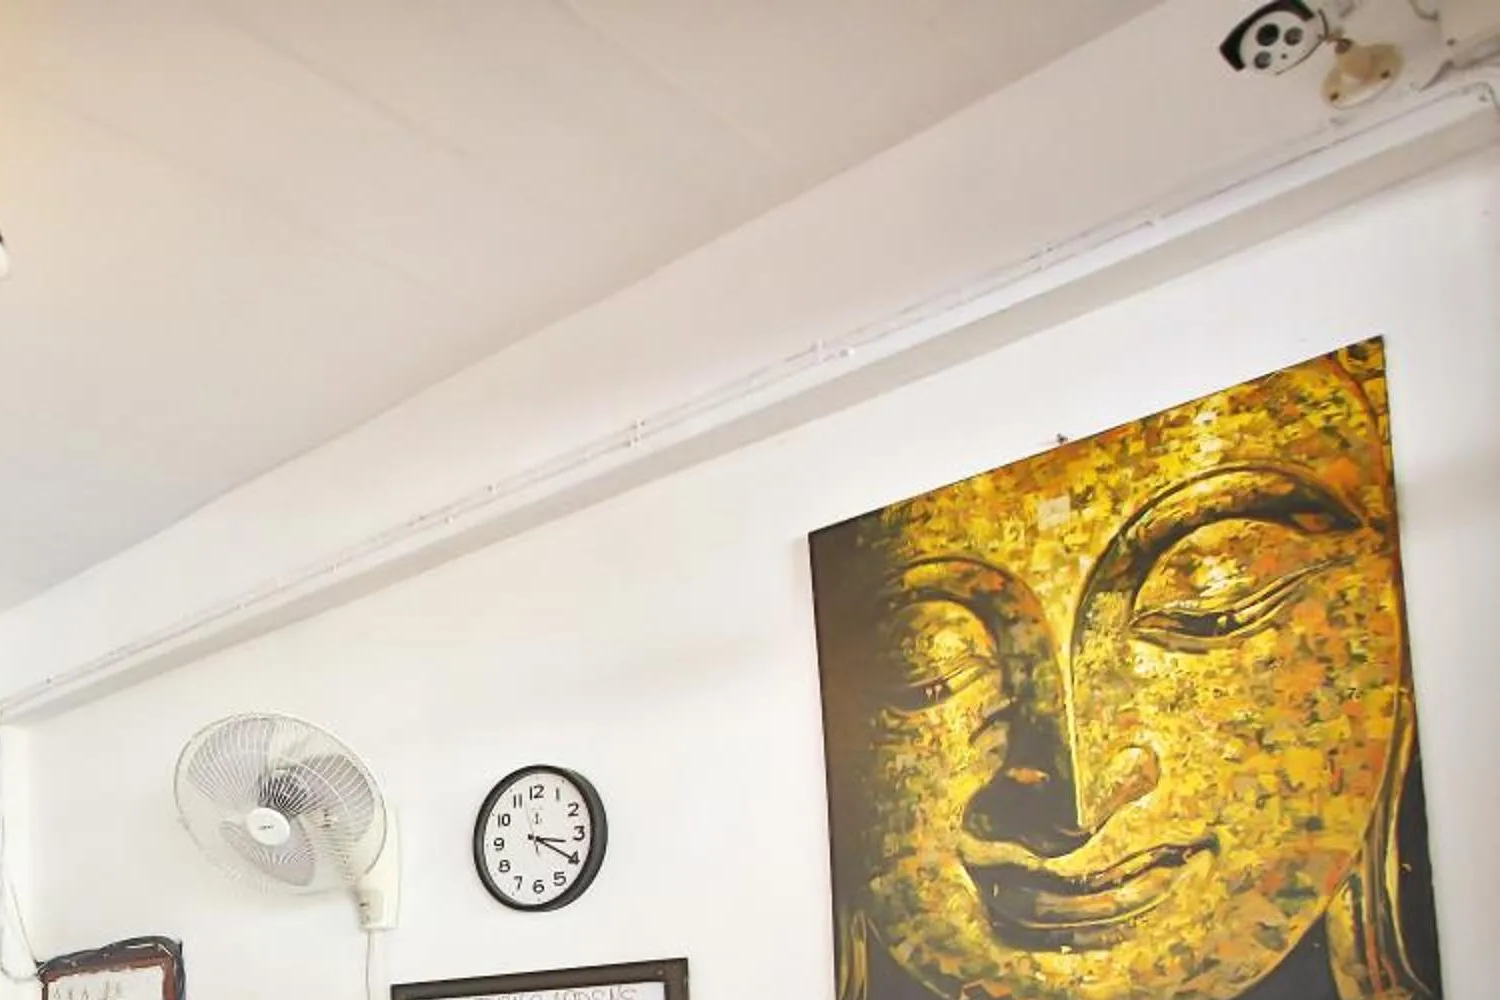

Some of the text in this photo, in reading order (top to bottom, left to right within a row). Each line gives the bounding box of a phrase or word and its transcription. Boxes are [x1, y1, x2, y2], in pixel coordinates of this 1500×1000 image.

[529, 784, 545, 800] 12
[512, 793, 523, 809] 11
[567, 802, 580, 817] 2
[497, 813, 511, 827] 10
[573, 825, 586, 841] 3
[493, 837, 505, 851] 9
[498, 859, 511, 873] 8
[567, 851, 580, 866] 4
[513, 875, 523, 890] 7
[532, 879, 545, 894] 6
[553, 871, 567, 887] 5
